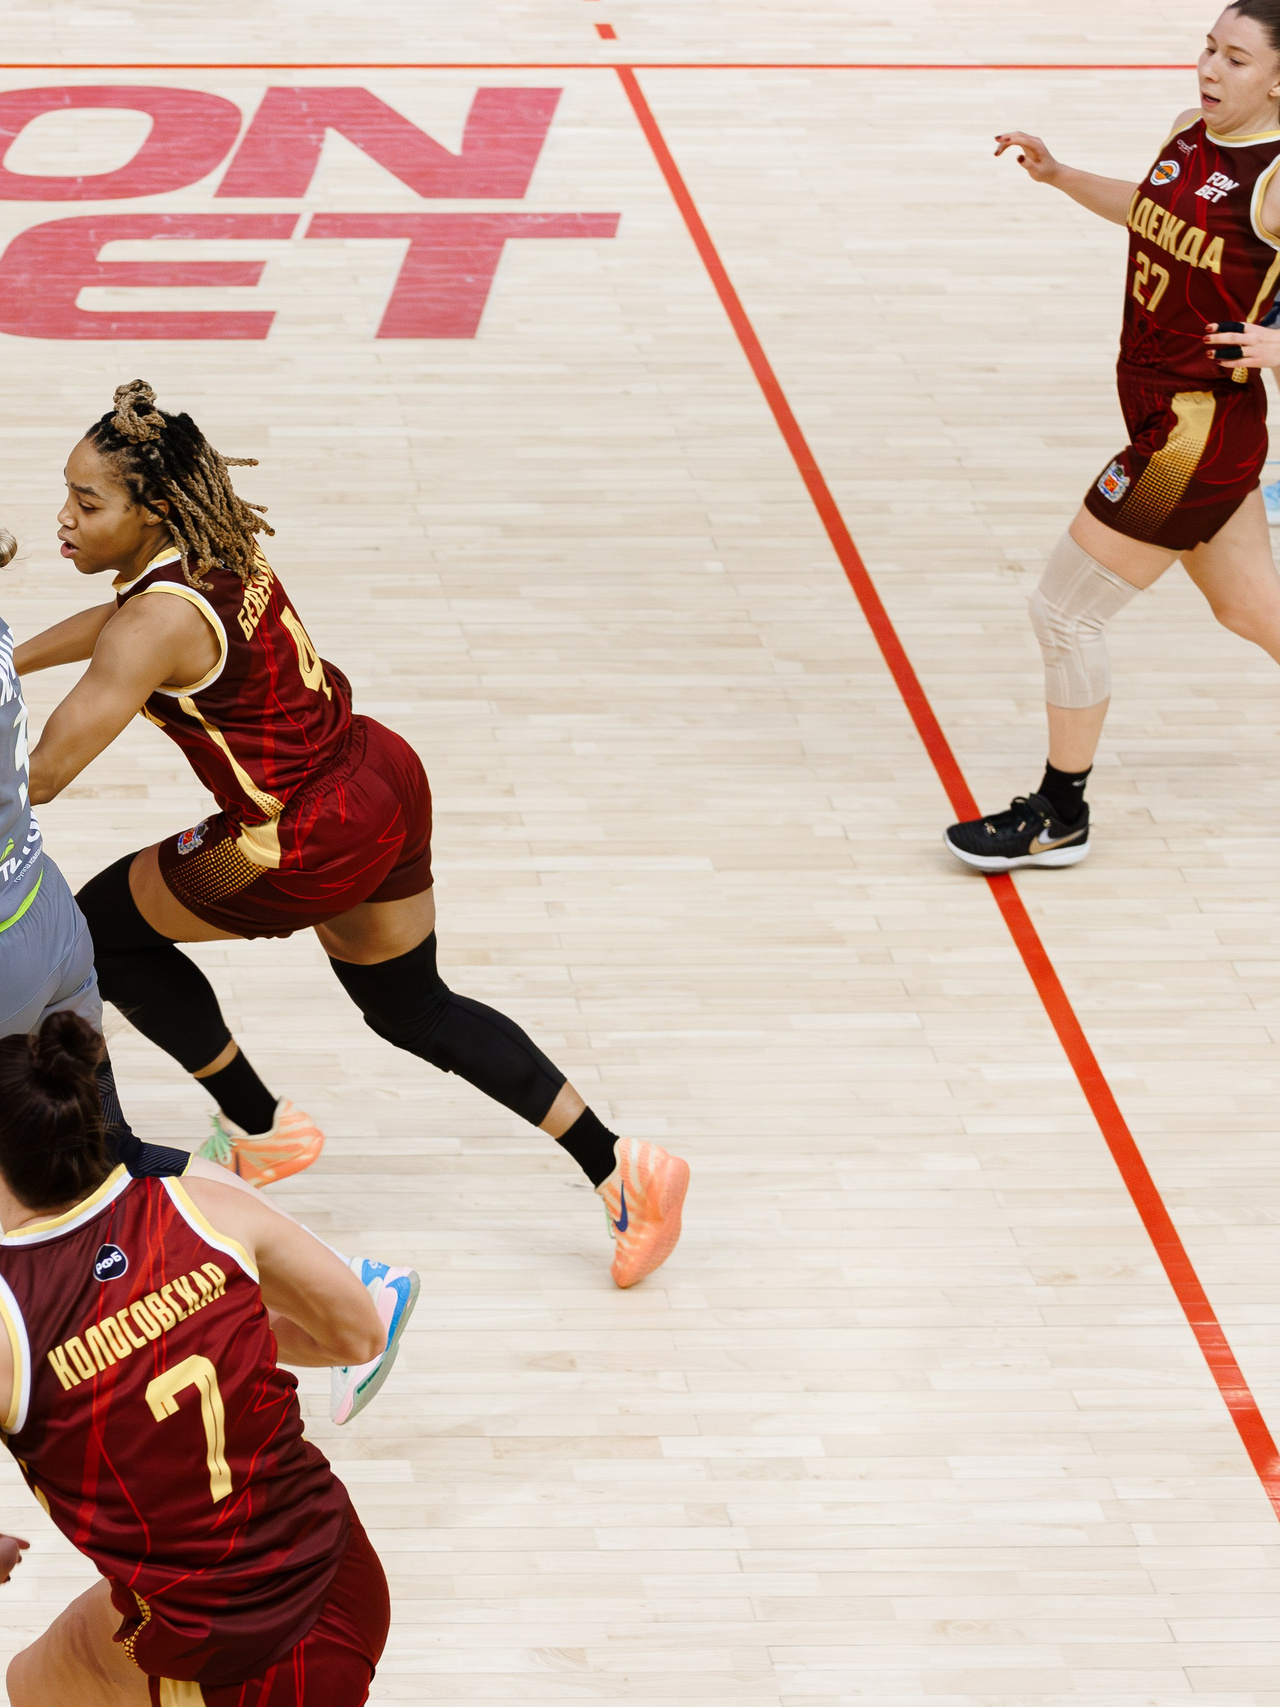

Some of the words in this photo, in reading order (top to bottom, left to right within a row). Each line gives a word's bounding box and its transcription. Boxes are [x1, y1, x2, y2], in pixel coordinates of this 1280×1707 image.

[1194, 184, 1228, 203] BET
[1206, 171, 1240, 191] FON
[1132, 251, 1170, 312] 27
[280, 605, 332, 701] 4
[95, 1250, 123, 1275] РФБ
[47, 1262, 227, 1391] КОЛОСОВСКАЯ
[145, 1354, 233, 1504] 7
